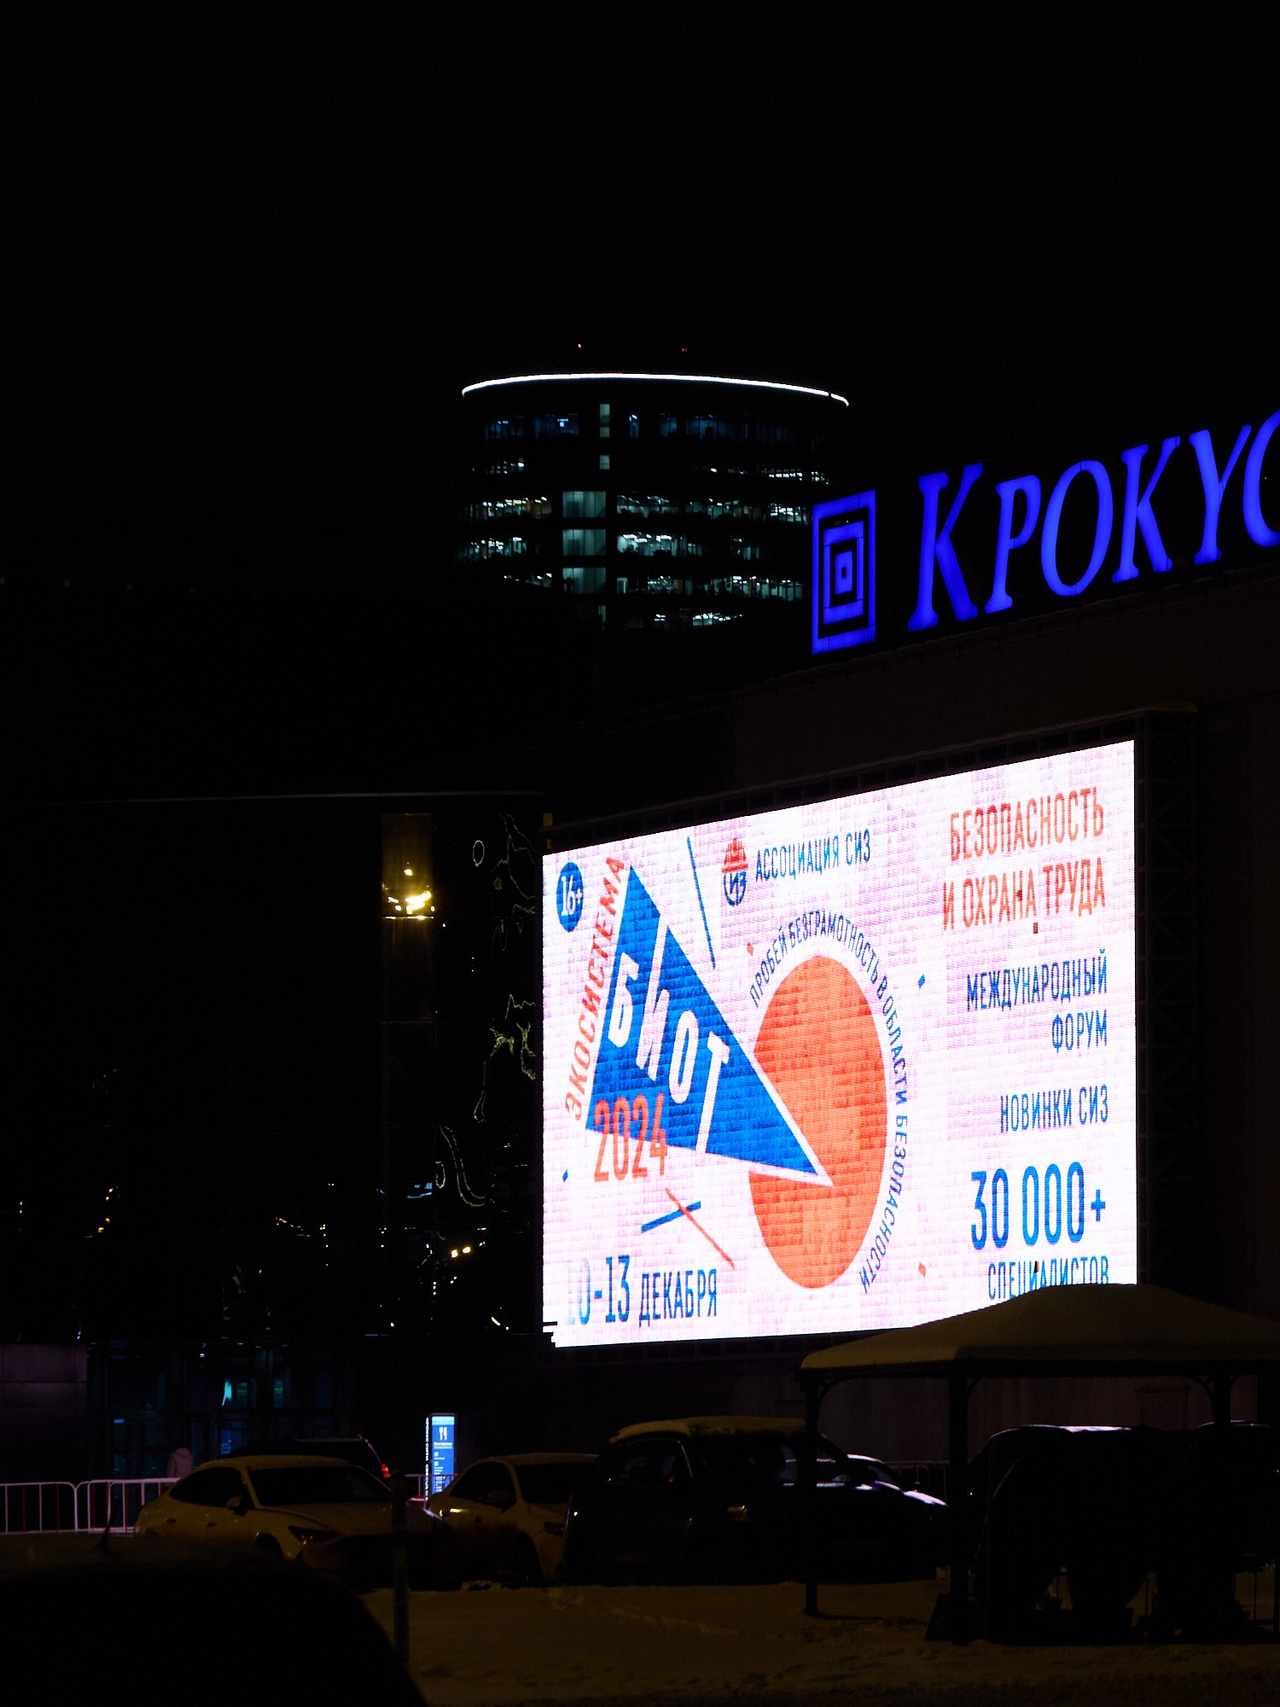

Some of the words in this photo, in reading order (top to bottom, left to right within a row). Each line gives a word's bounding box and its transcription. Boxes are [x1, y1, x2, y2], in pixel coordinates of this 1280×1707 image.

[756, 835, 839, 882] АССОЦИАЦИЯ
[846, 829, 871, 866] СИЗ
[950, 787, 1104, 862] БЕЗОПАСНОСТЬ
[560, 874, 583, 917] 16+
[943, 881, 955, 930] И
[963, 868, 1037, 928] ОХРАНА
[1043, 857, 1106, 917] ТРУДА
[750, 926, 788, 1008] ПРОБЕЙ
[788, 909, 880, 985] БЕЗГРАМОТНОСТЬ
[967, 948, 1108, 1011] МЕЖДУНАРОДНЫЙ
[565, 857, 625, 1121] ЭКОСИСТЕМА
[608, 952, 730, 1153] БИОТ
[882, 995, 908, 1105] ОБЛАСТИ
[1051, 1009, 1108, 1052] ФОРУМ
[593, 1092, 668, 1182] 2024
[1000, 1088, 1072, 1133] НОВИНКИ
[1078, 1084, 1109, 1125] СИЗ
[859, 1115, 908, 1294] БЕЗОПАСНОСТИ
[971, 1167, 1010, 1250] 30
[1022, 1161, 1106, 1246] 000+
[639, 1268, 718, 1327] ДЕКАБРЯ
